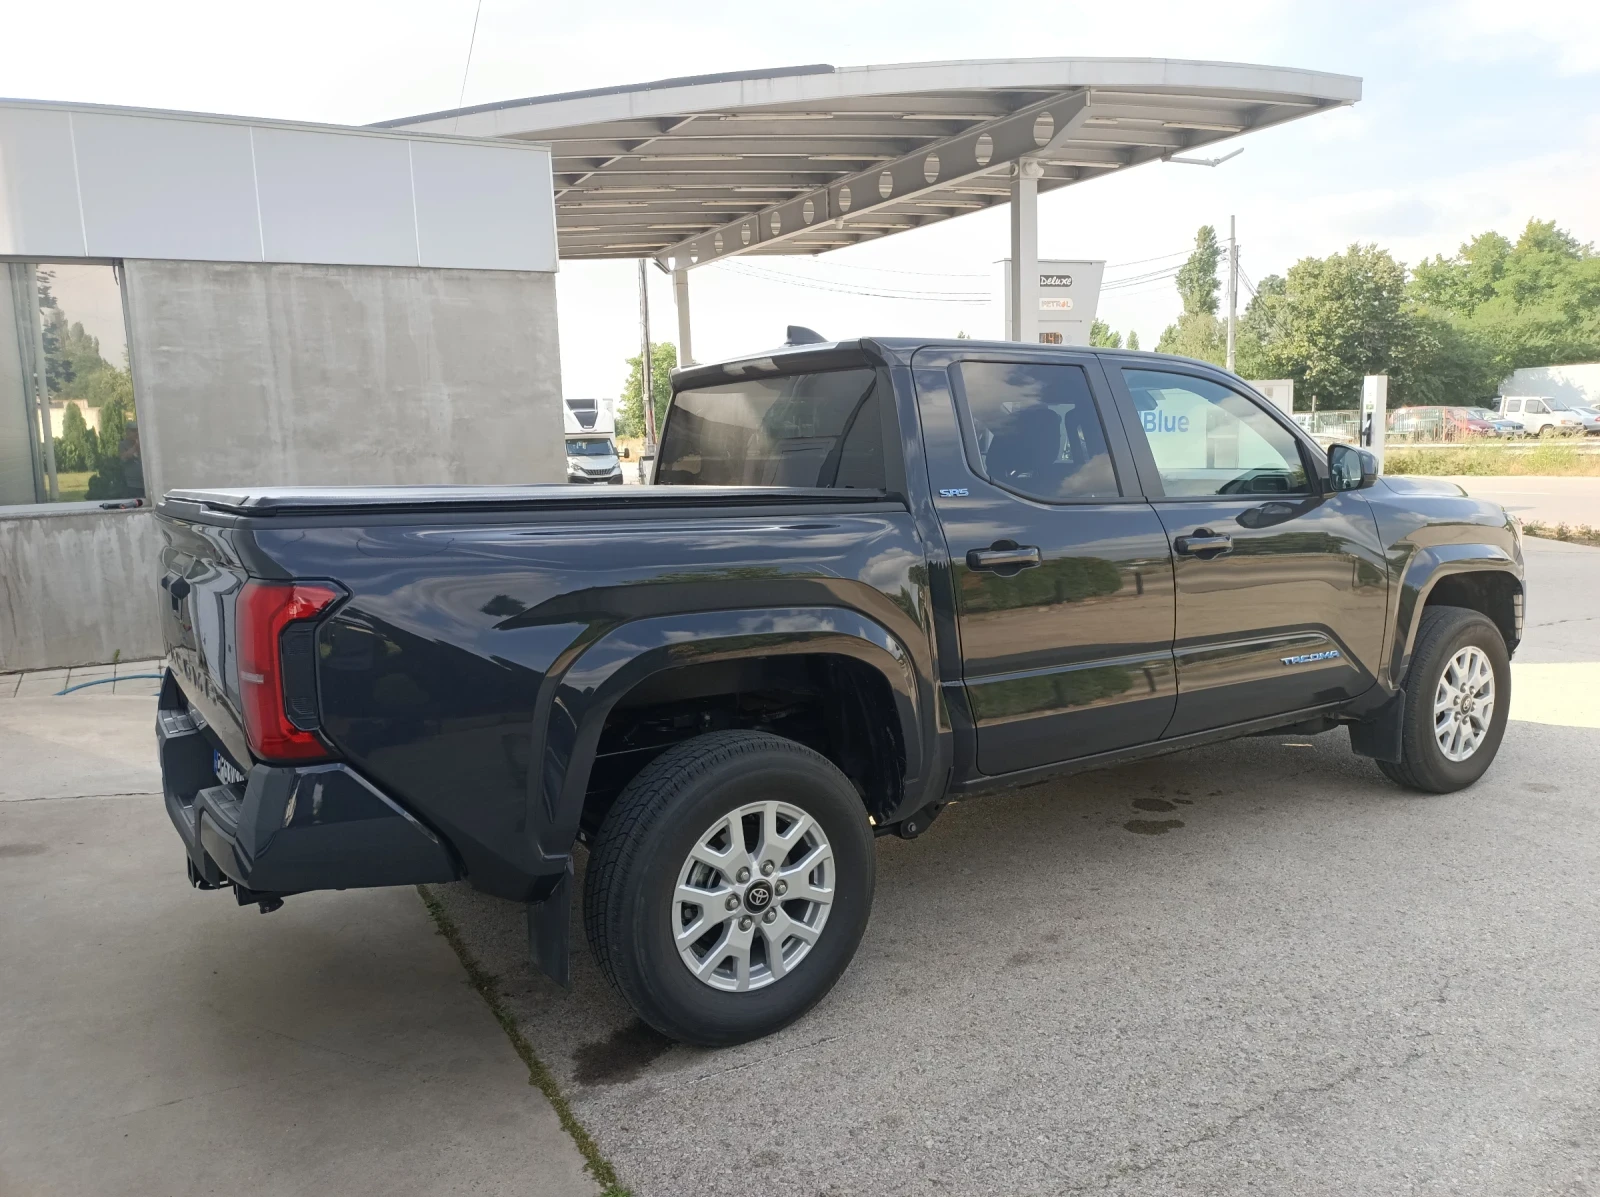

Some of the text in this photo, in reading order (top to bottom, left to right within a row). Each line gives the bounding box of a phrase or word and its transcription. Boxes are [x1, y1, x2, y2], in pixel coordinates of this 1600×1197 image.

[1040, 276, 1071, 285] Deluxe
[1139, 410, 1190, 433] Blue
[1280, 650, 1340, 665] TACOMA
